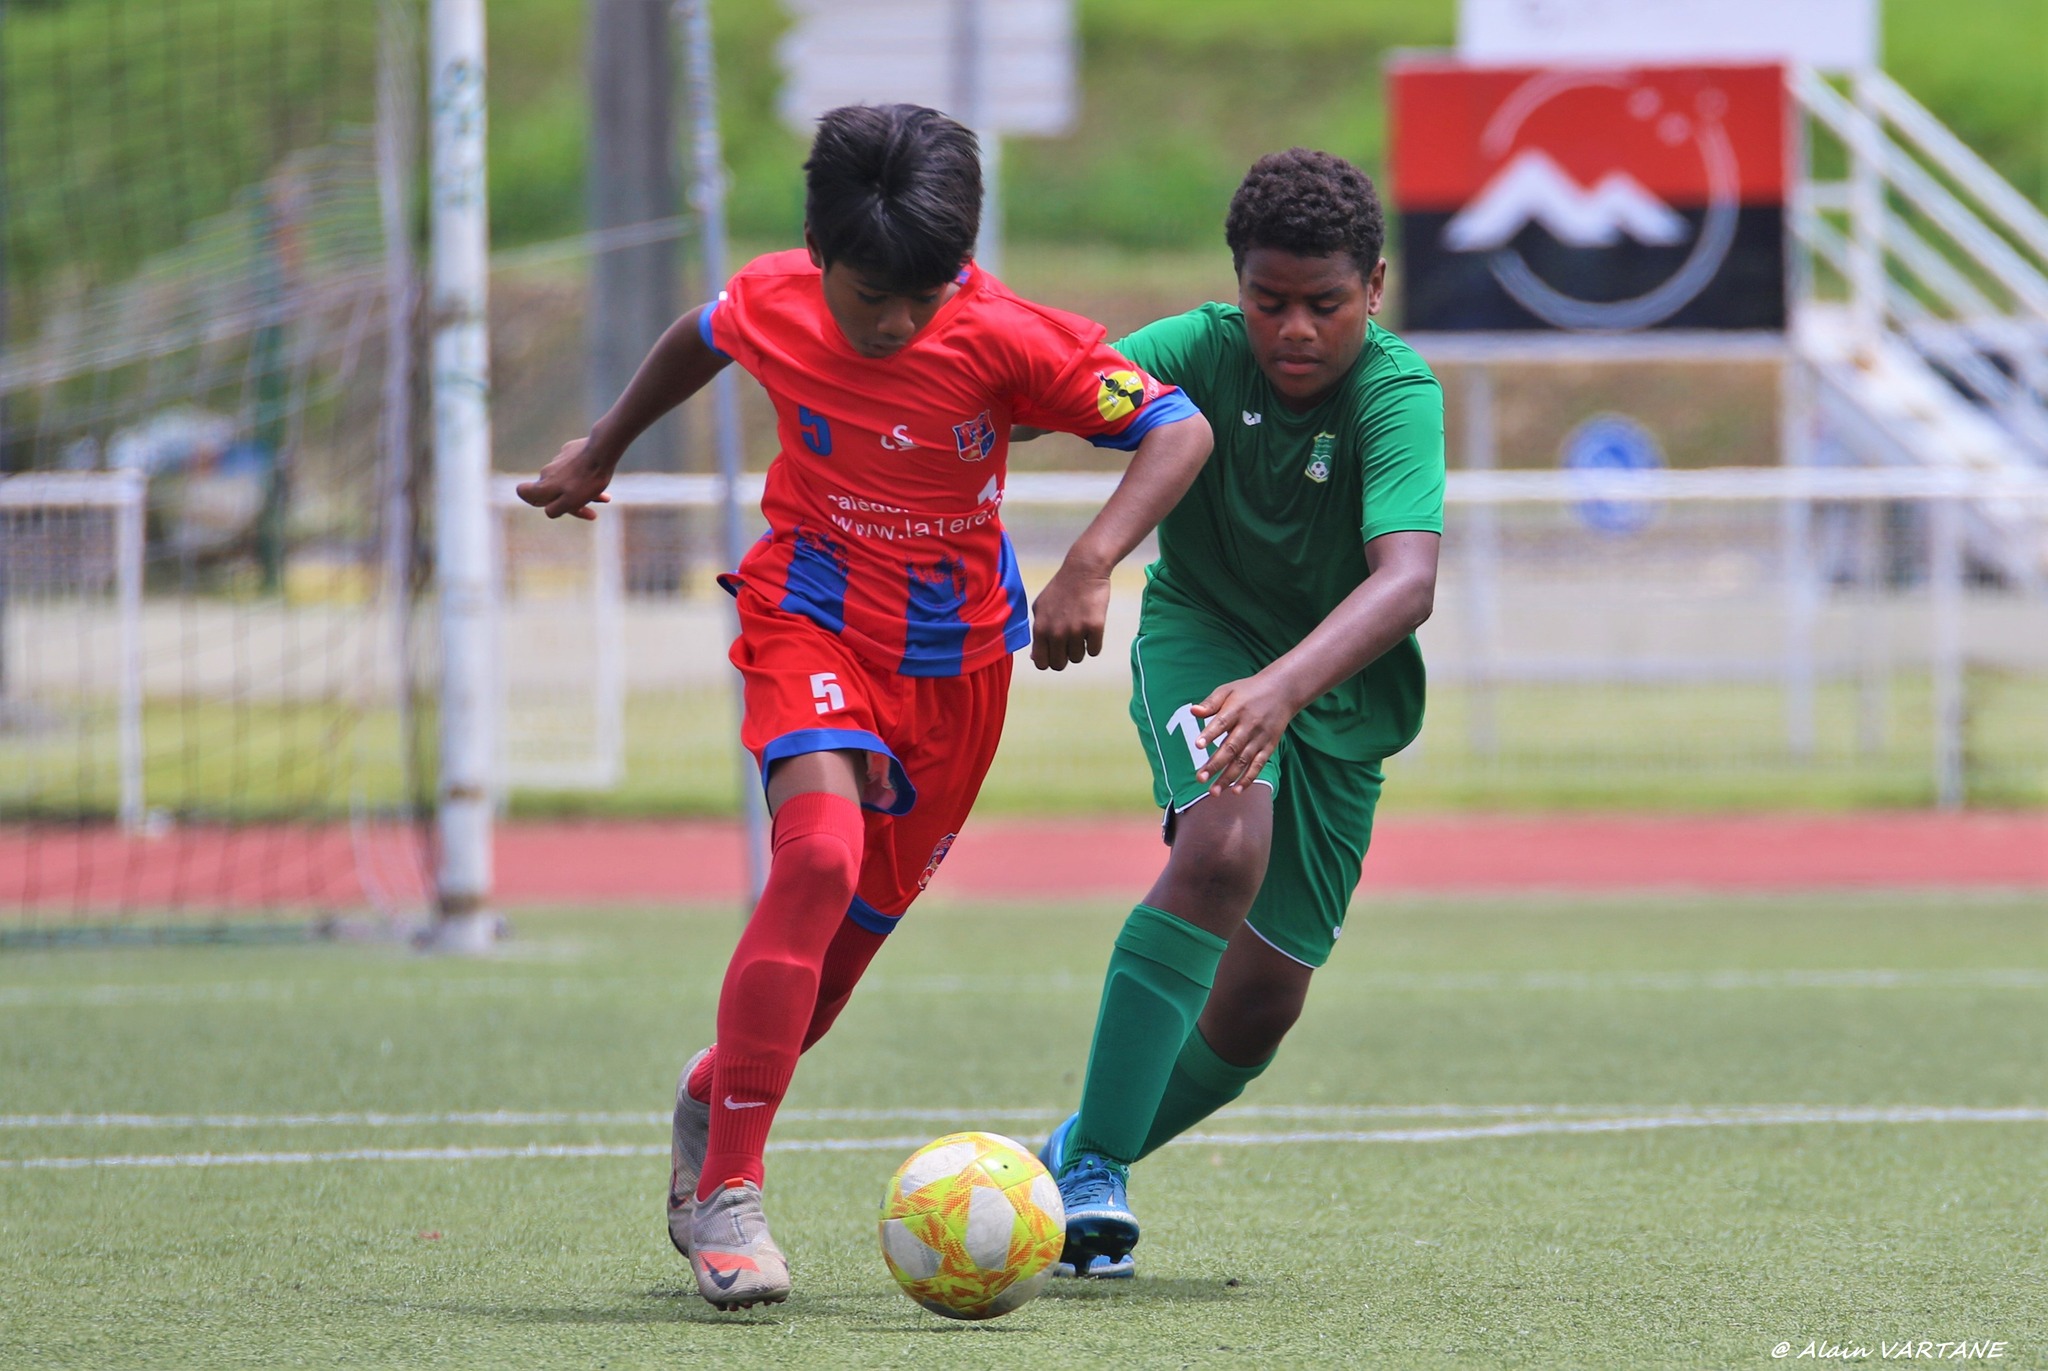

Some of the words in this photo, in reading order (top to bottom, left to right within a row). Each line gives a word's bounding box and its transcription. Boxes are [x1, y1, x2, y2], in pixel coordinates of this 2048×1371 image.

[799, 404, 832, 457] 5
[809, 672, 845, 715] 5
[1165, 703, 1230, 771] 1
